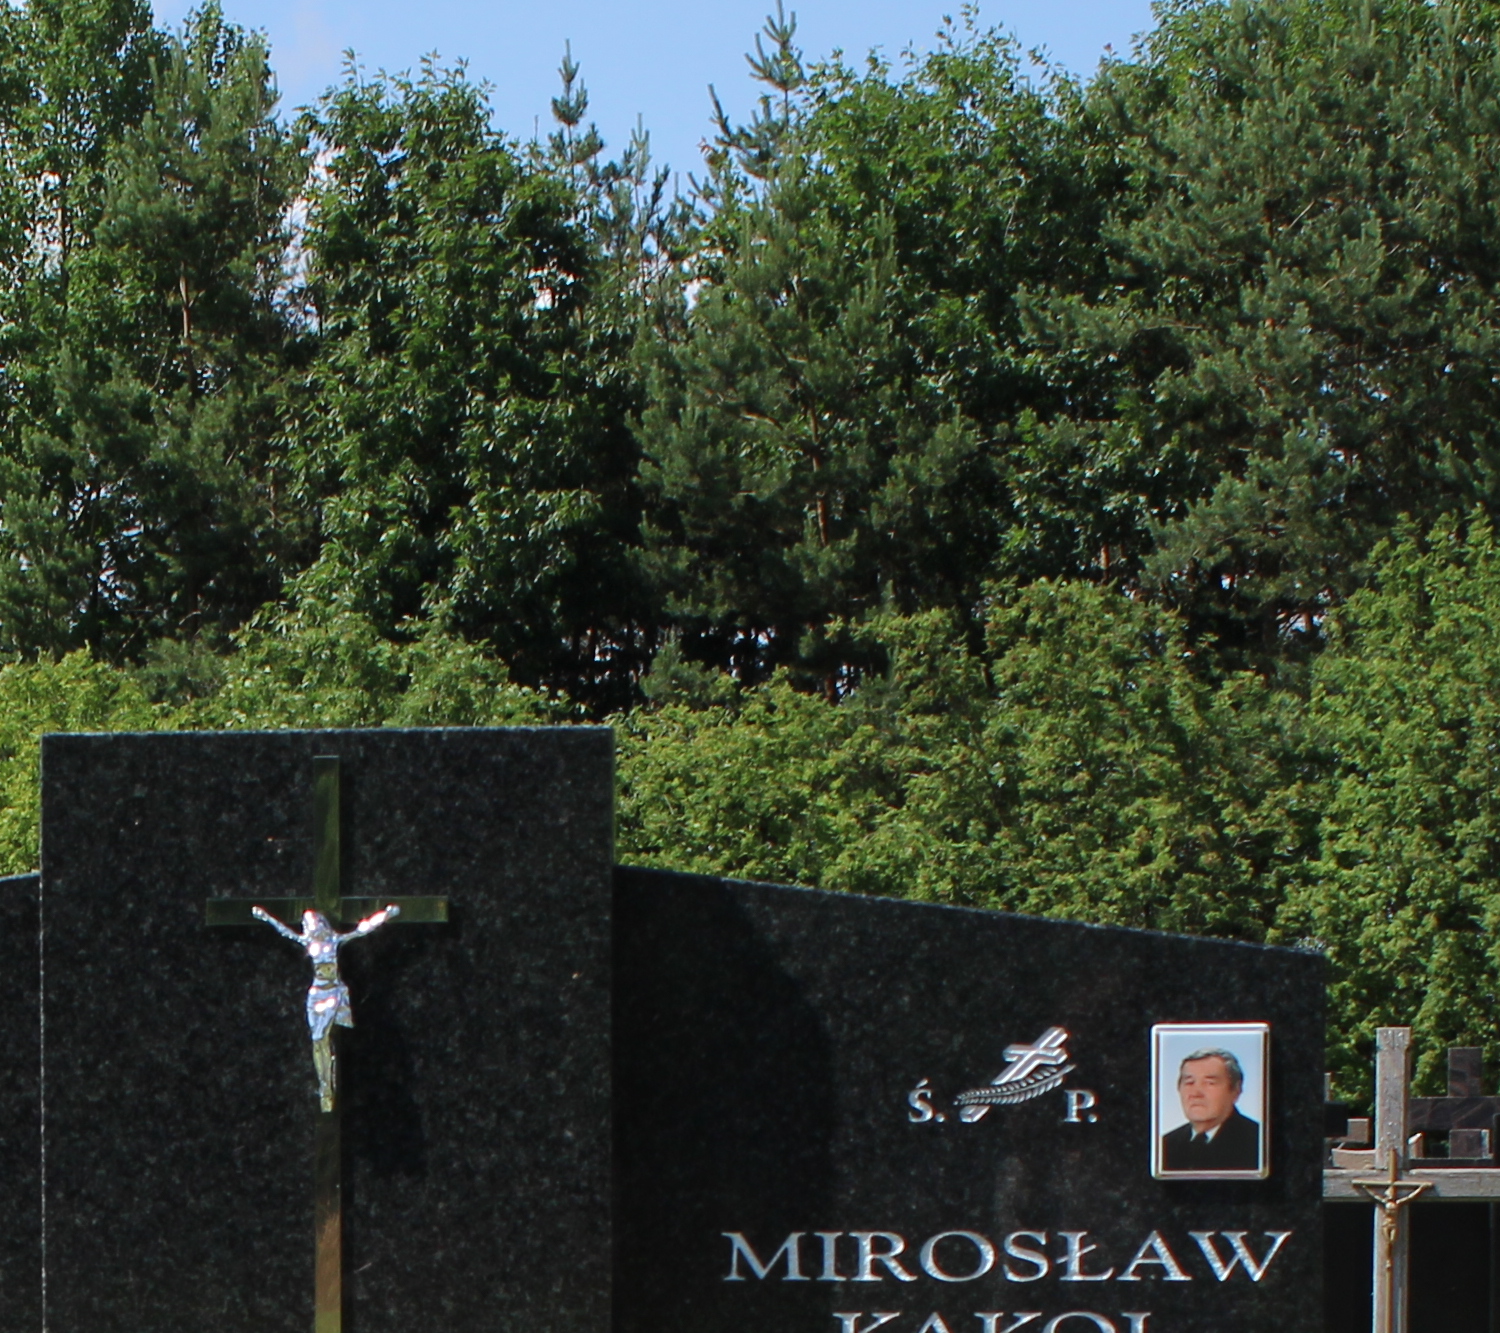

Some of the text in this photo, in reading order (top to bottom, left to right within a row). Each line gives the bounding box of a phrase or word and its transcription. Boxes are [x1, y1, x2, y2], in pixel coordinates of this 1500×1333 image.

[908, 1078, 1098, 1123] Ś. P.
[721, 1230, 1293, 1283] MIROSŁAW
